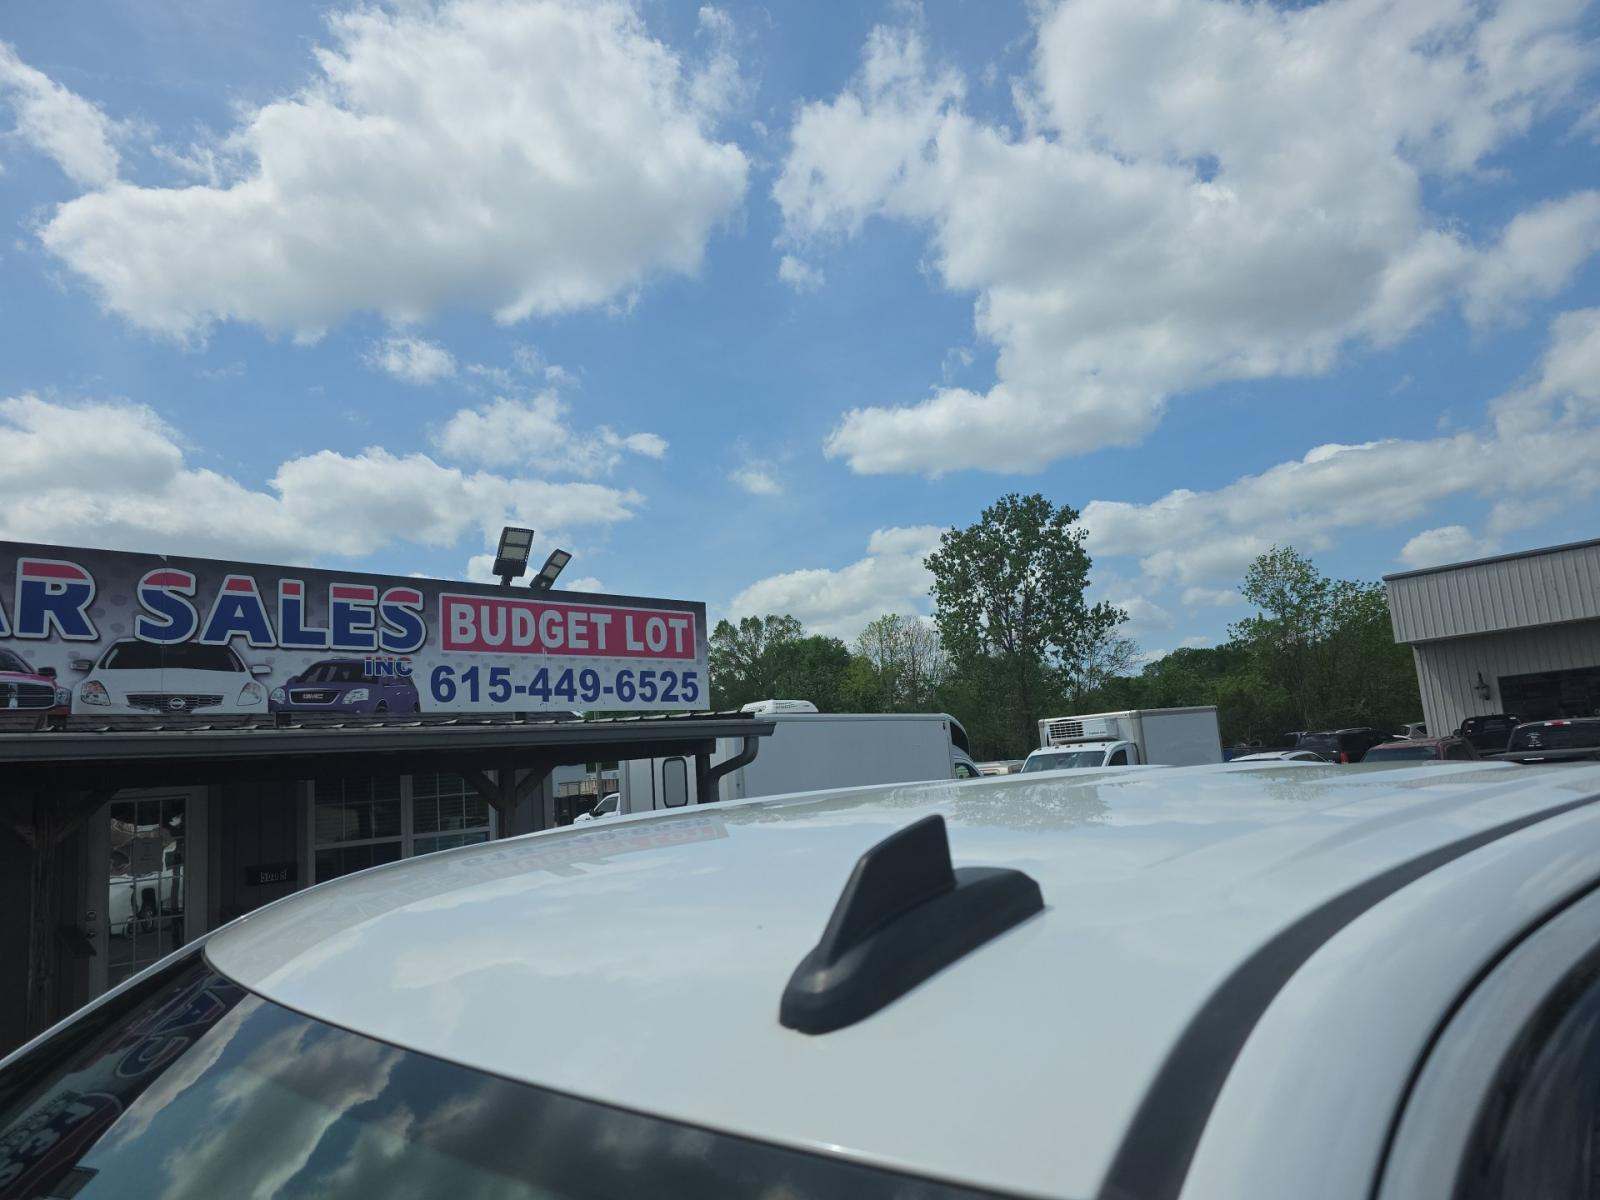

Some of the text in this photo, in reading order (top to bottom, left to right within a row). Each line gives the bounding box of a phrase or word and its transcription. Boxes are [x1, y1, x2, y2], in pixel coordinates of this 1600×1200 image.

[0, 557, 427, 653] R SALES
[449, 602, 689, 653] BUDGET LOT
[364, 655, 415, 677] INC
[430, 665, 699, 703] 615-449-6525
